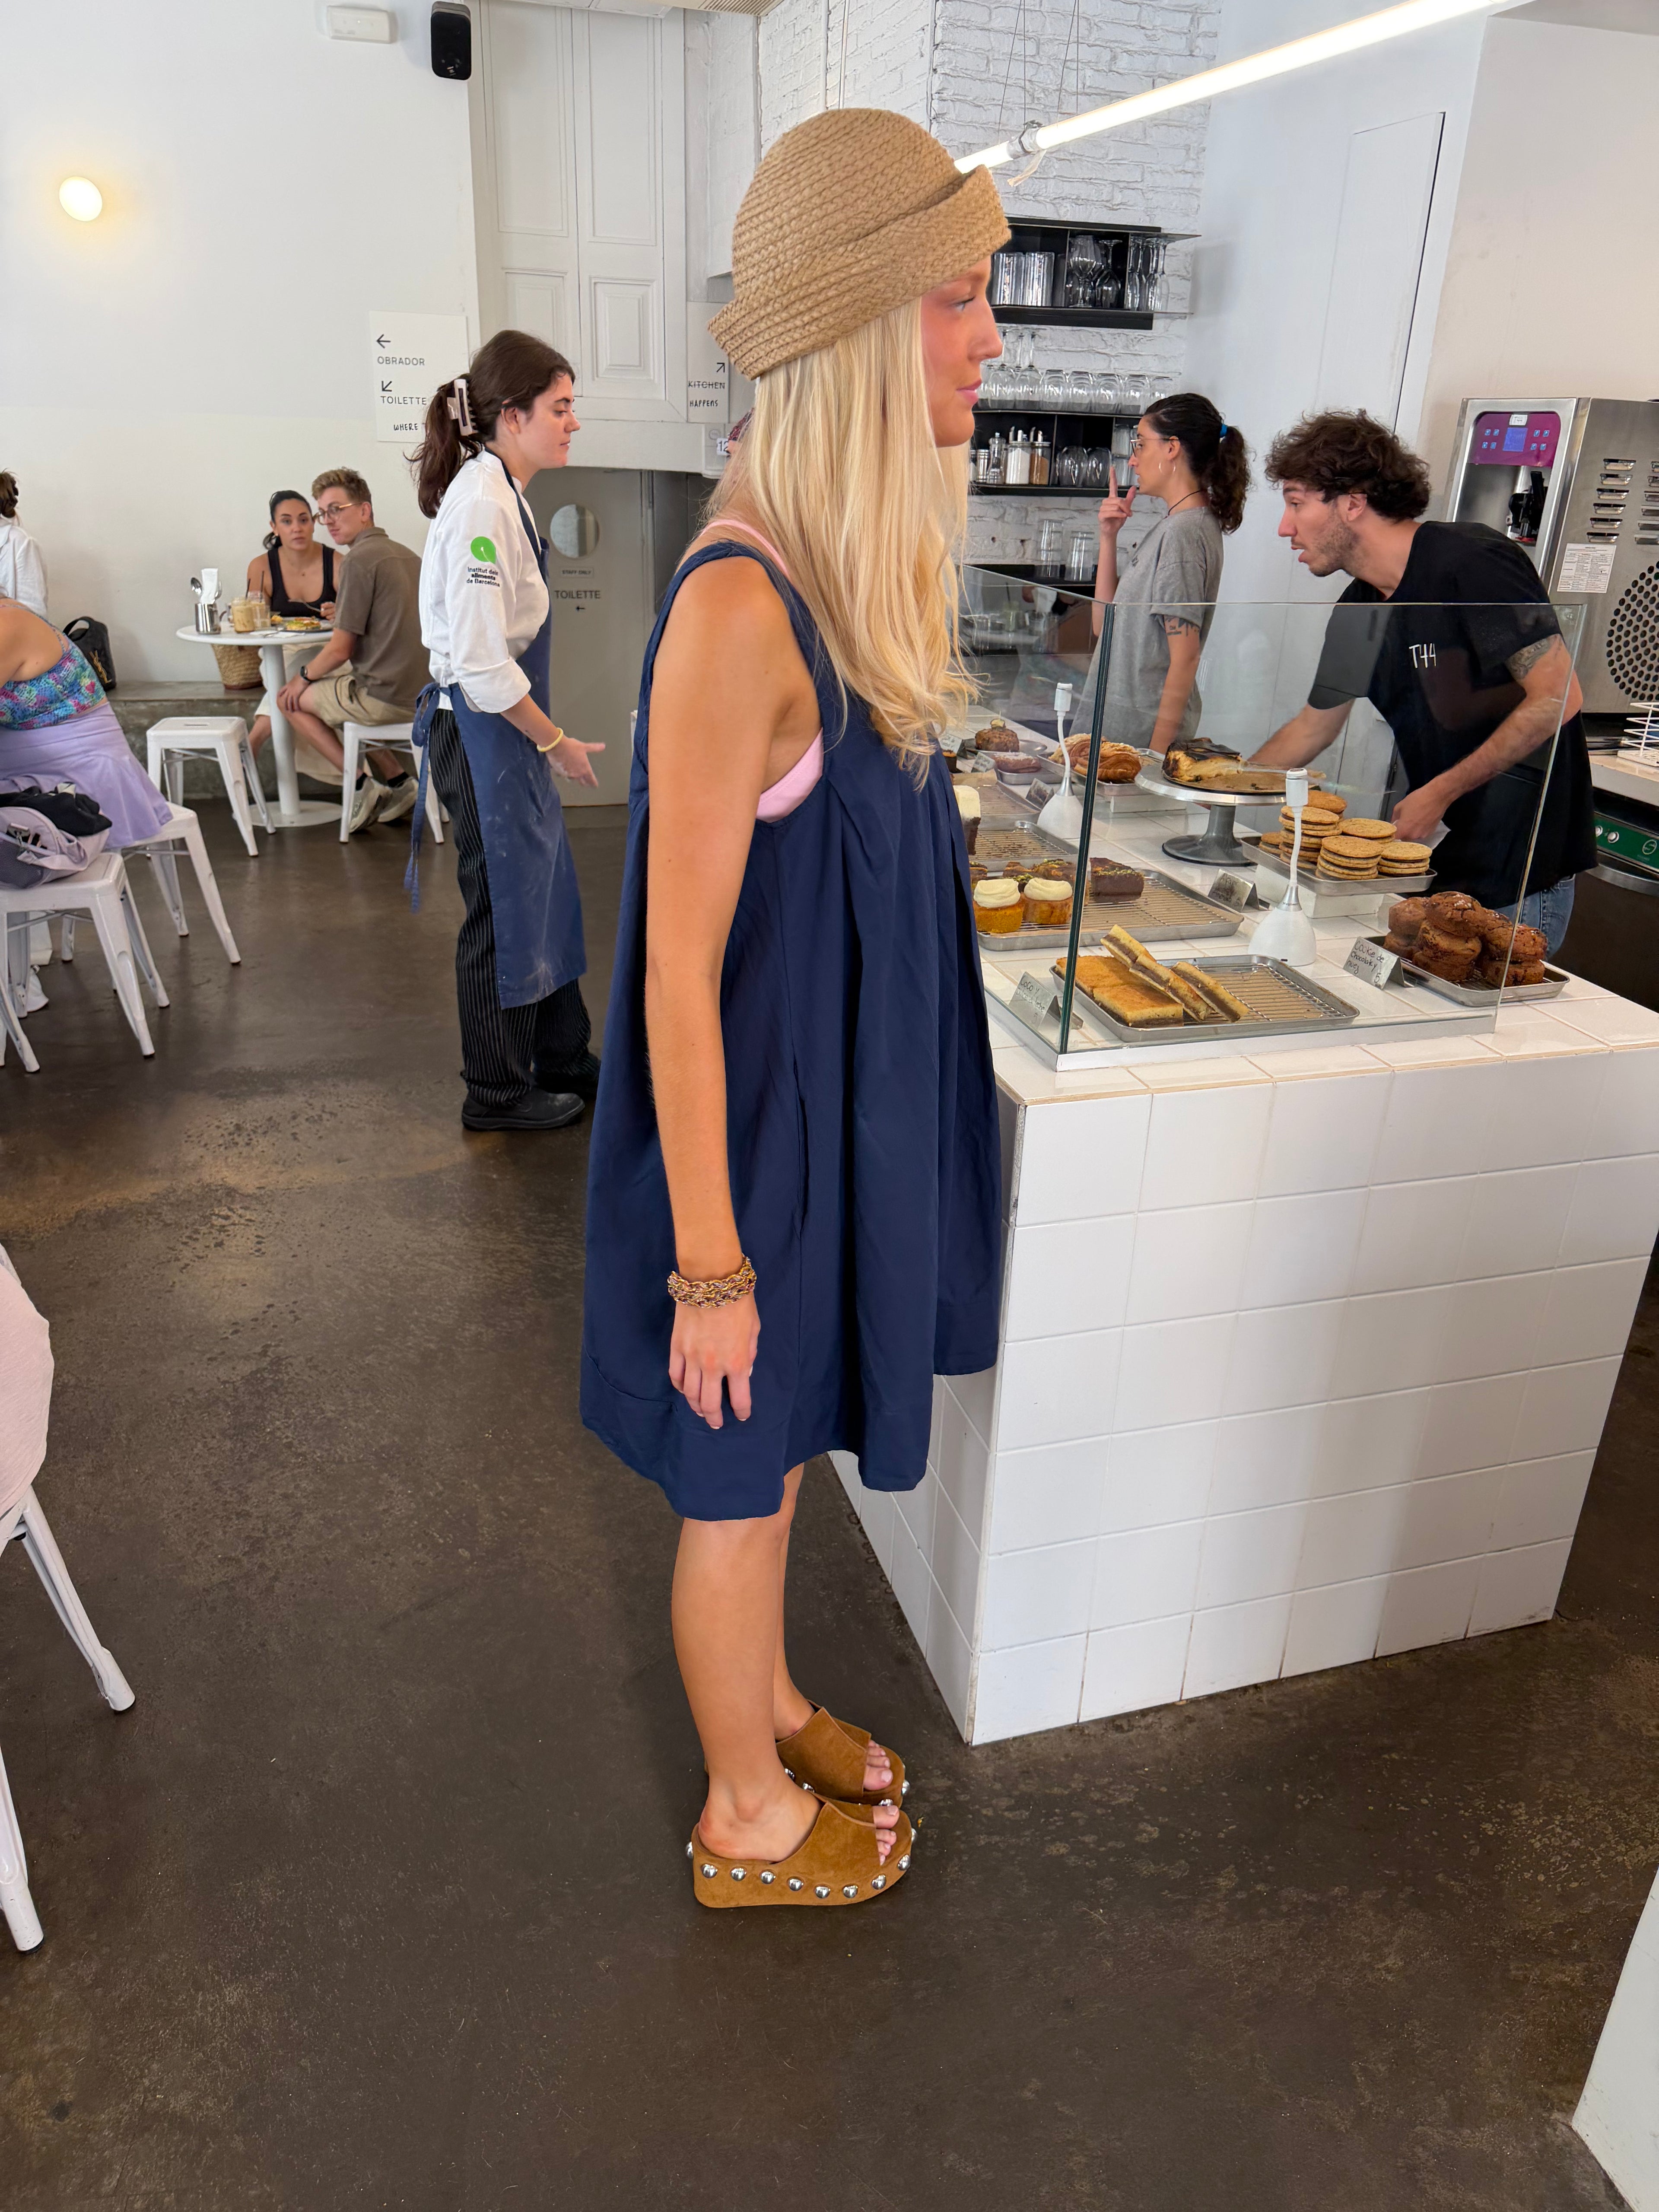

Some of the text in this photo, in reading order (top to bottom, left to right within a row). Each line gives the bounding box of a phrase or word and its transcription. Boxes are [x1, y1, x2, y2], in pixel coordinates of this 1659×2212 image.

[377, 356, 425, 365] OBRADOR
[688, 381, 725, 389] KITCHEN
[380, 396, 427, 405] TOILETTE
[554, 590, 601, 599] TOILETTE
[1409, 643, 1437, 668] T44
[1376, 954, 1384, 963] de
[1374, 973, 1382, 983] 5
